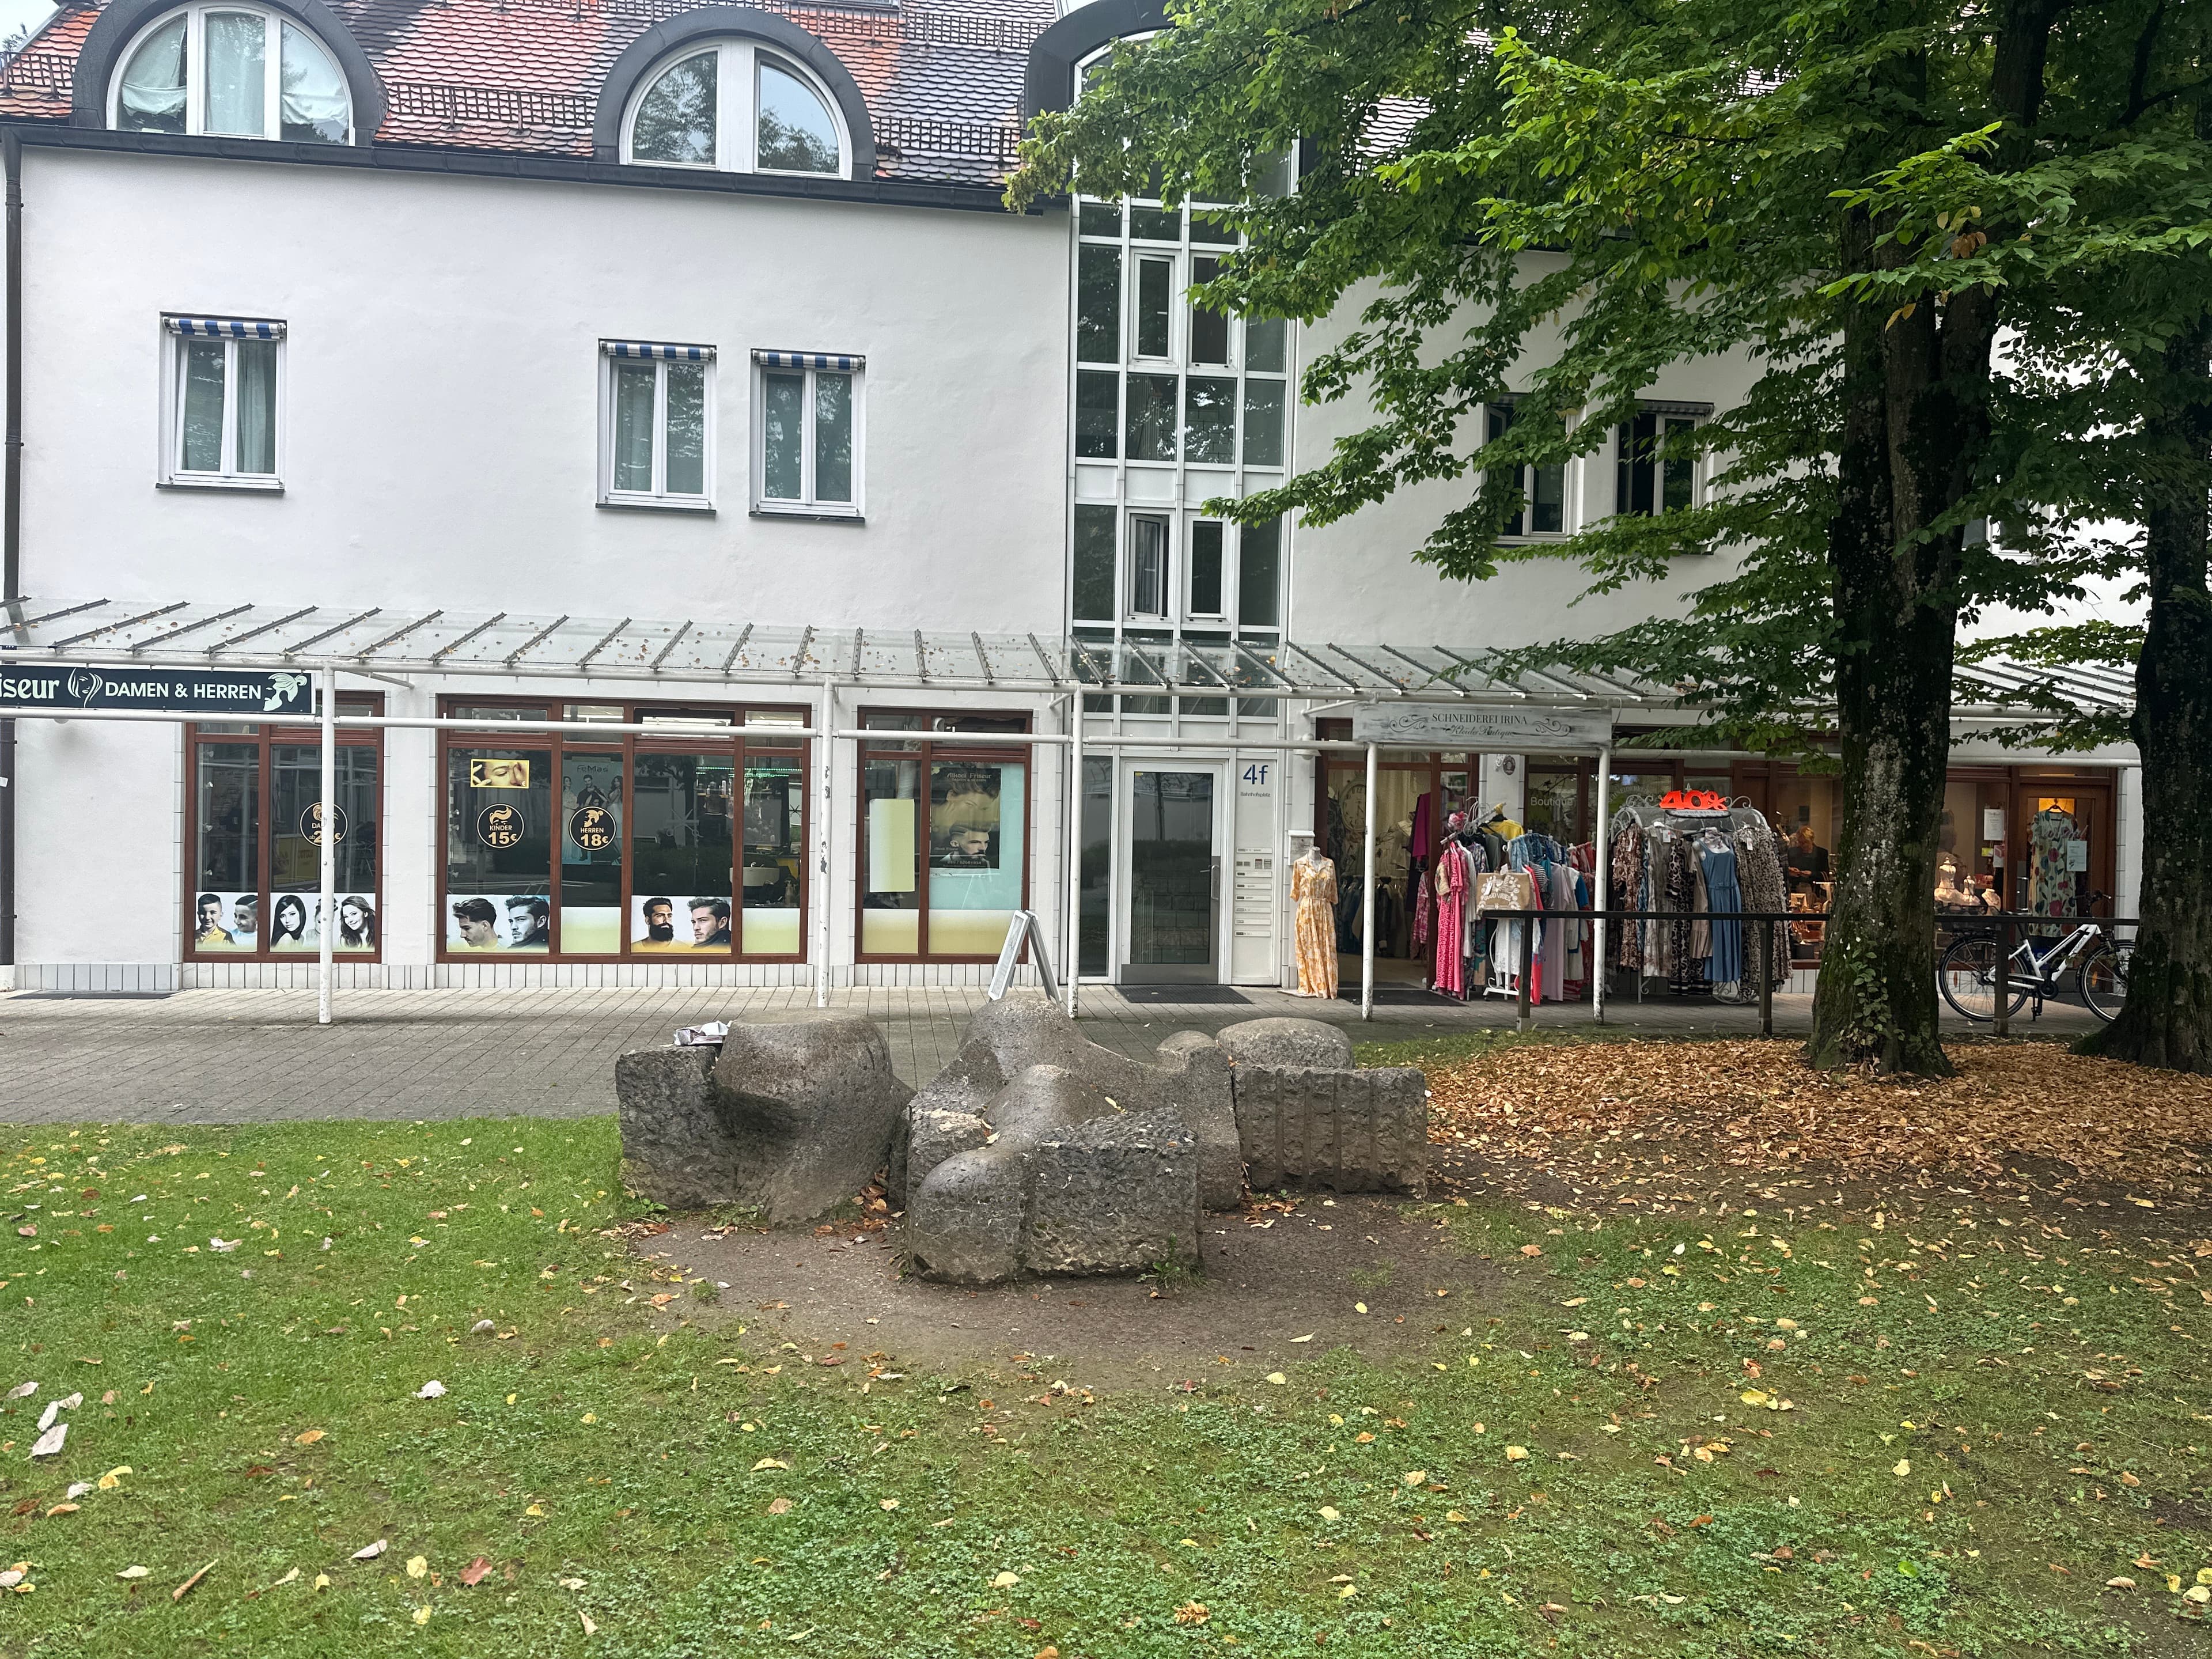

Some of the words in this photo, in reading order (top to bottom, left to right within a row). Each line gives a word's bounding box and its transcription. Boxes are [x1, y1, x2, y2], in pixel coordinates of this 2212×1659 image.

[105, 682, 169, 697] DAMEN
[175, 683, 188, 698] &
[194, 684, 261, 699] HERREN
[1432, 713, 1498, 724] SCHNEIDEREI
[1501, 715, 1528, 725] IRINA
[1243, 764, 1268, 785] 4f
[1530, 797, 1573, 810] Boutique
[1659, 790, 1728, 810] 40%
